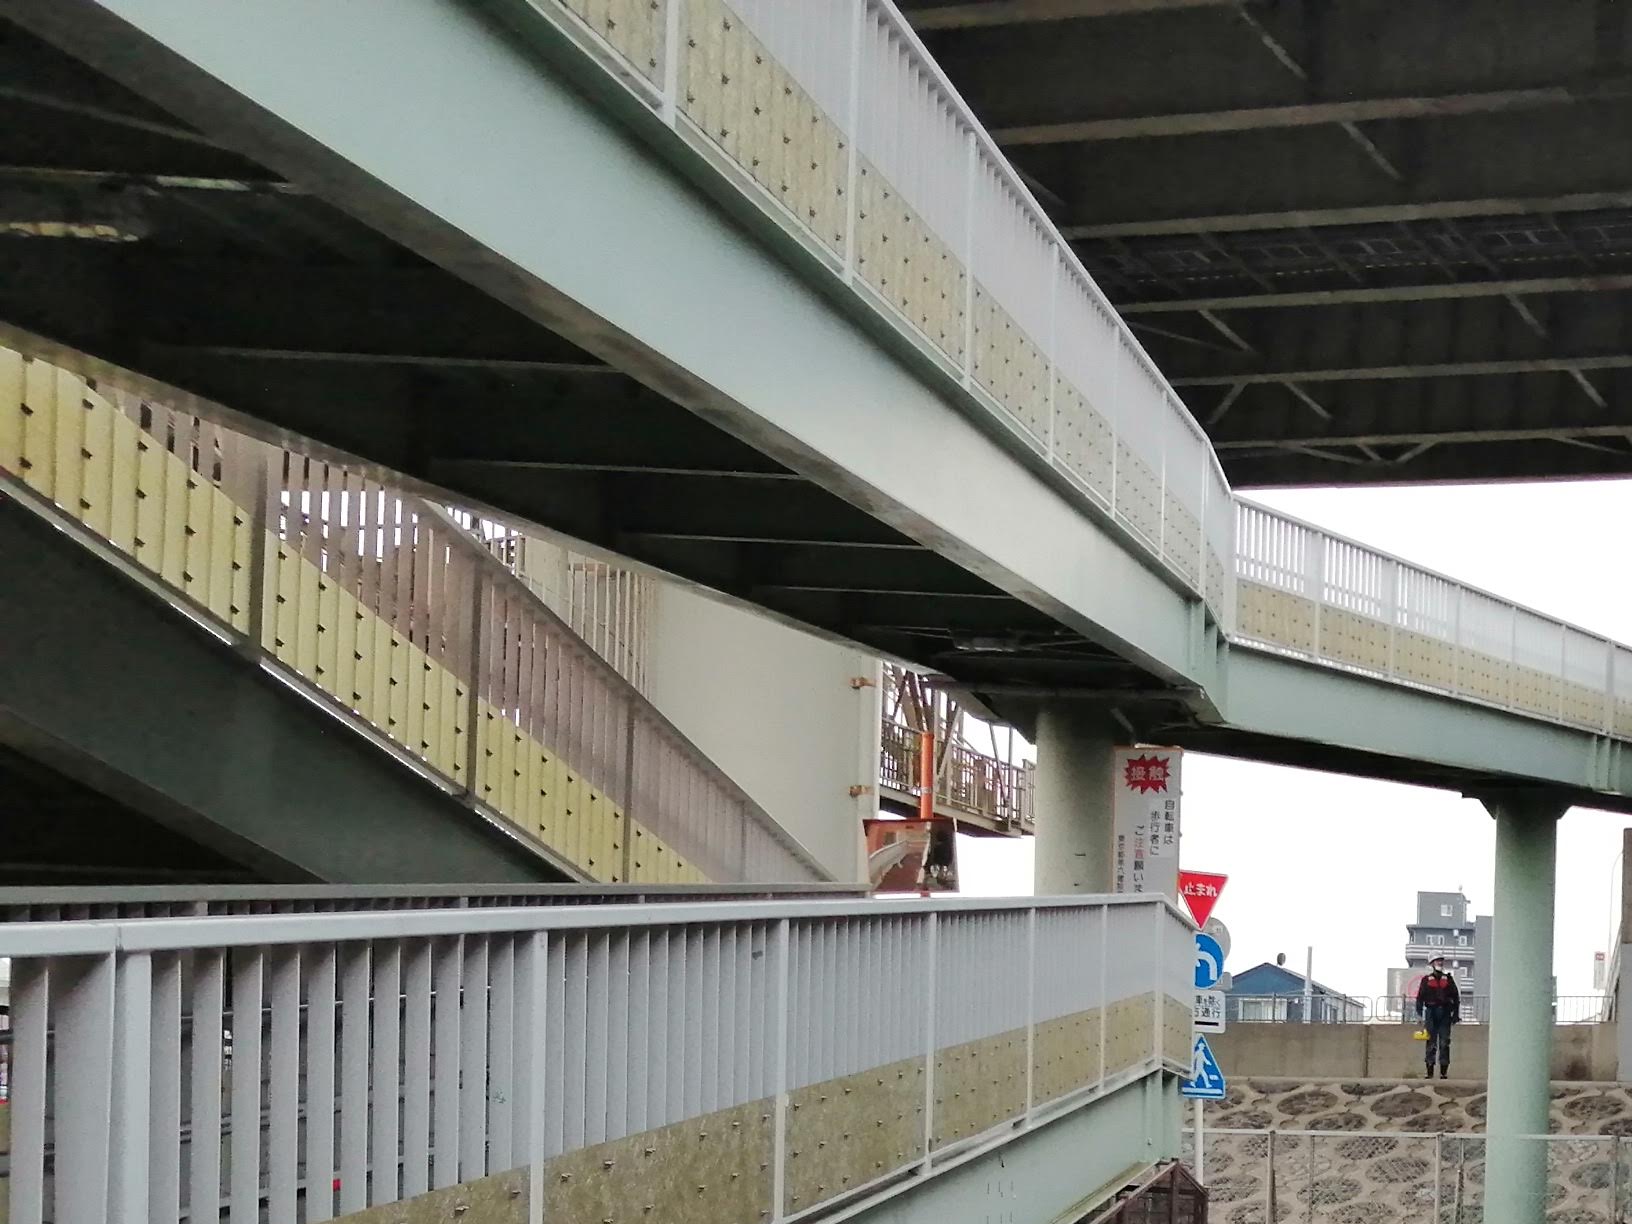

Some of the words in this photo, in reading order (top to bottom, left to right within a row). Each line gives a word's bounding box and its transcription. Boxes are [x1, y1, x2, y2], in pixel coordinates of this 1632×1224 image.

[1131, 766, 1164, 781] 接触
[1150, 810, 1161, 856] 歩行者に
[1163, 799, 1175, 846] 自転車は
[1184, 882, 1218, 898] 止まれ
